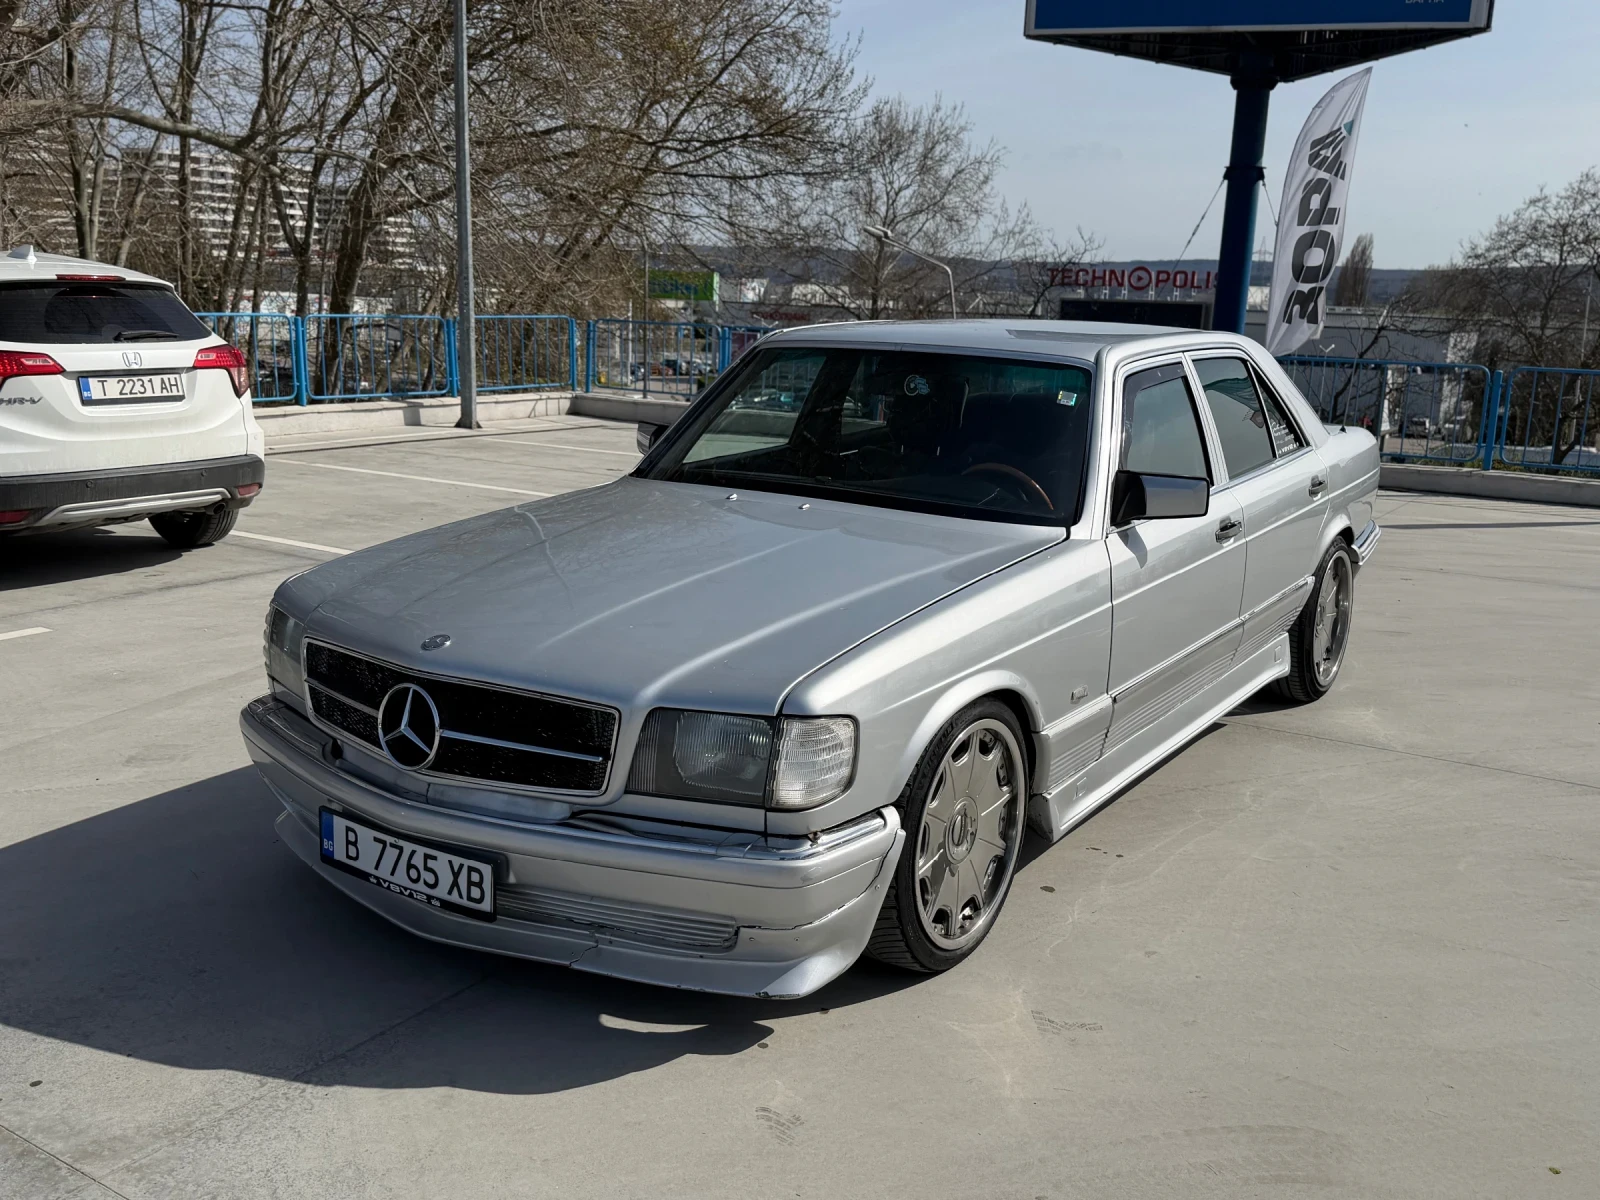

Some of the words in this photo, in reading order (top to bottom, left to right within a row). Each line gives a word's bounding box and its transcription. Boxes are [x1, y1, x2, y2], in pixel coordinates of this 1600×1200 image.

[1047, 266, 1219, 291] TECHNOPOLI
[97, 379, 108, 397] T
[116, 378, 156, 396] 2231
[160, 376, 180, 394] AH
[323, 838, 334, 851] BG
[345, 825, 360, 862] B
[373, 836, 439, 890] 7765
[447, 859, 485, 905] XB
